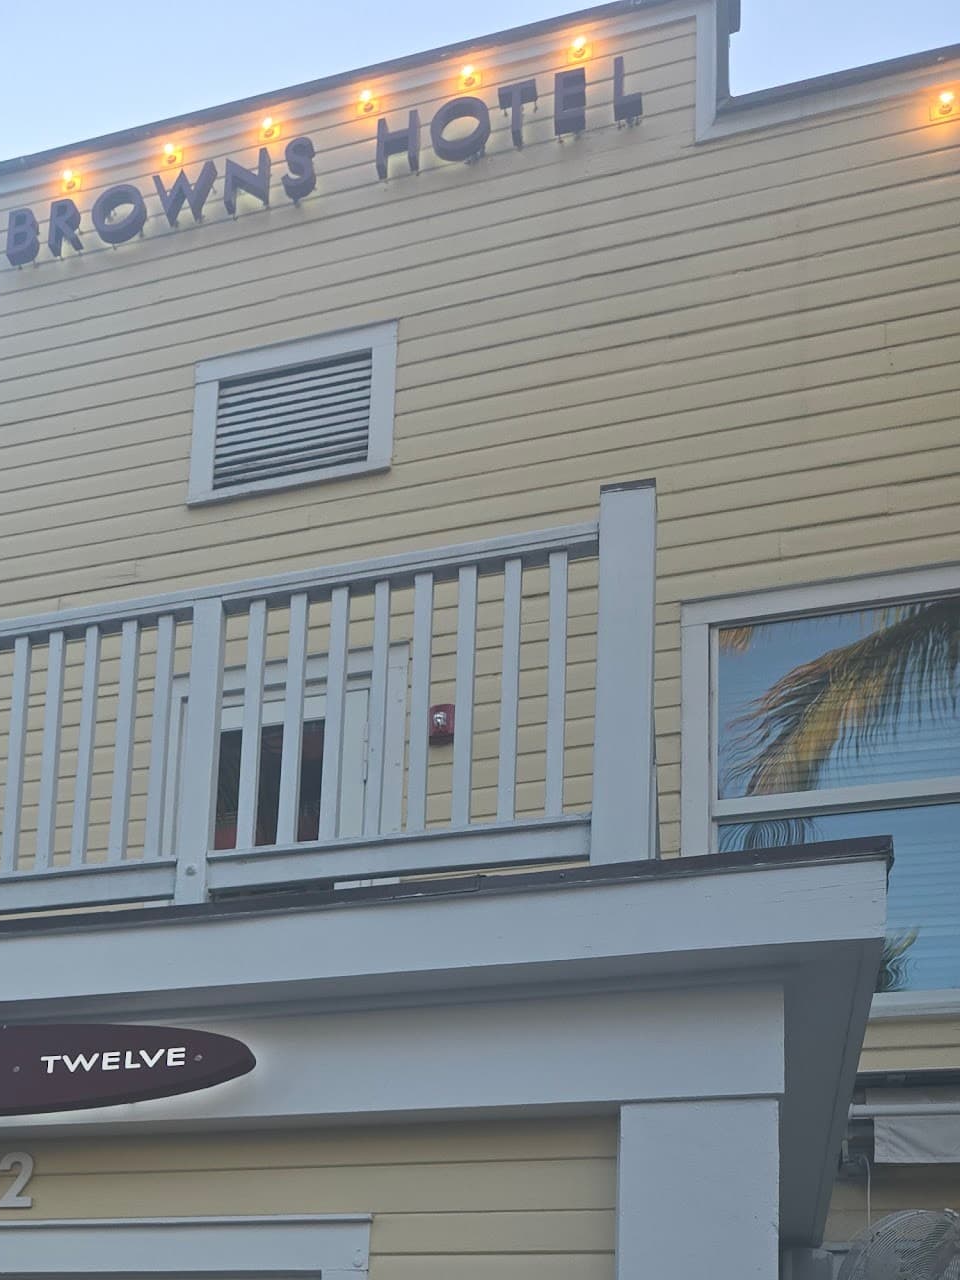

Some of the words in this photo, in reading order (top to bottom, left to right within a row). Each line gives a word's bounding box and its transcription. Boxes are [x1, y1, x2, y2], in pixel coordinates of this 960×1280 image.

[6, 136, 315, 267] BROWNS
[376, 56, 642, 180] HOTEL
[40, 1046, 187, 1075] TWELVE
